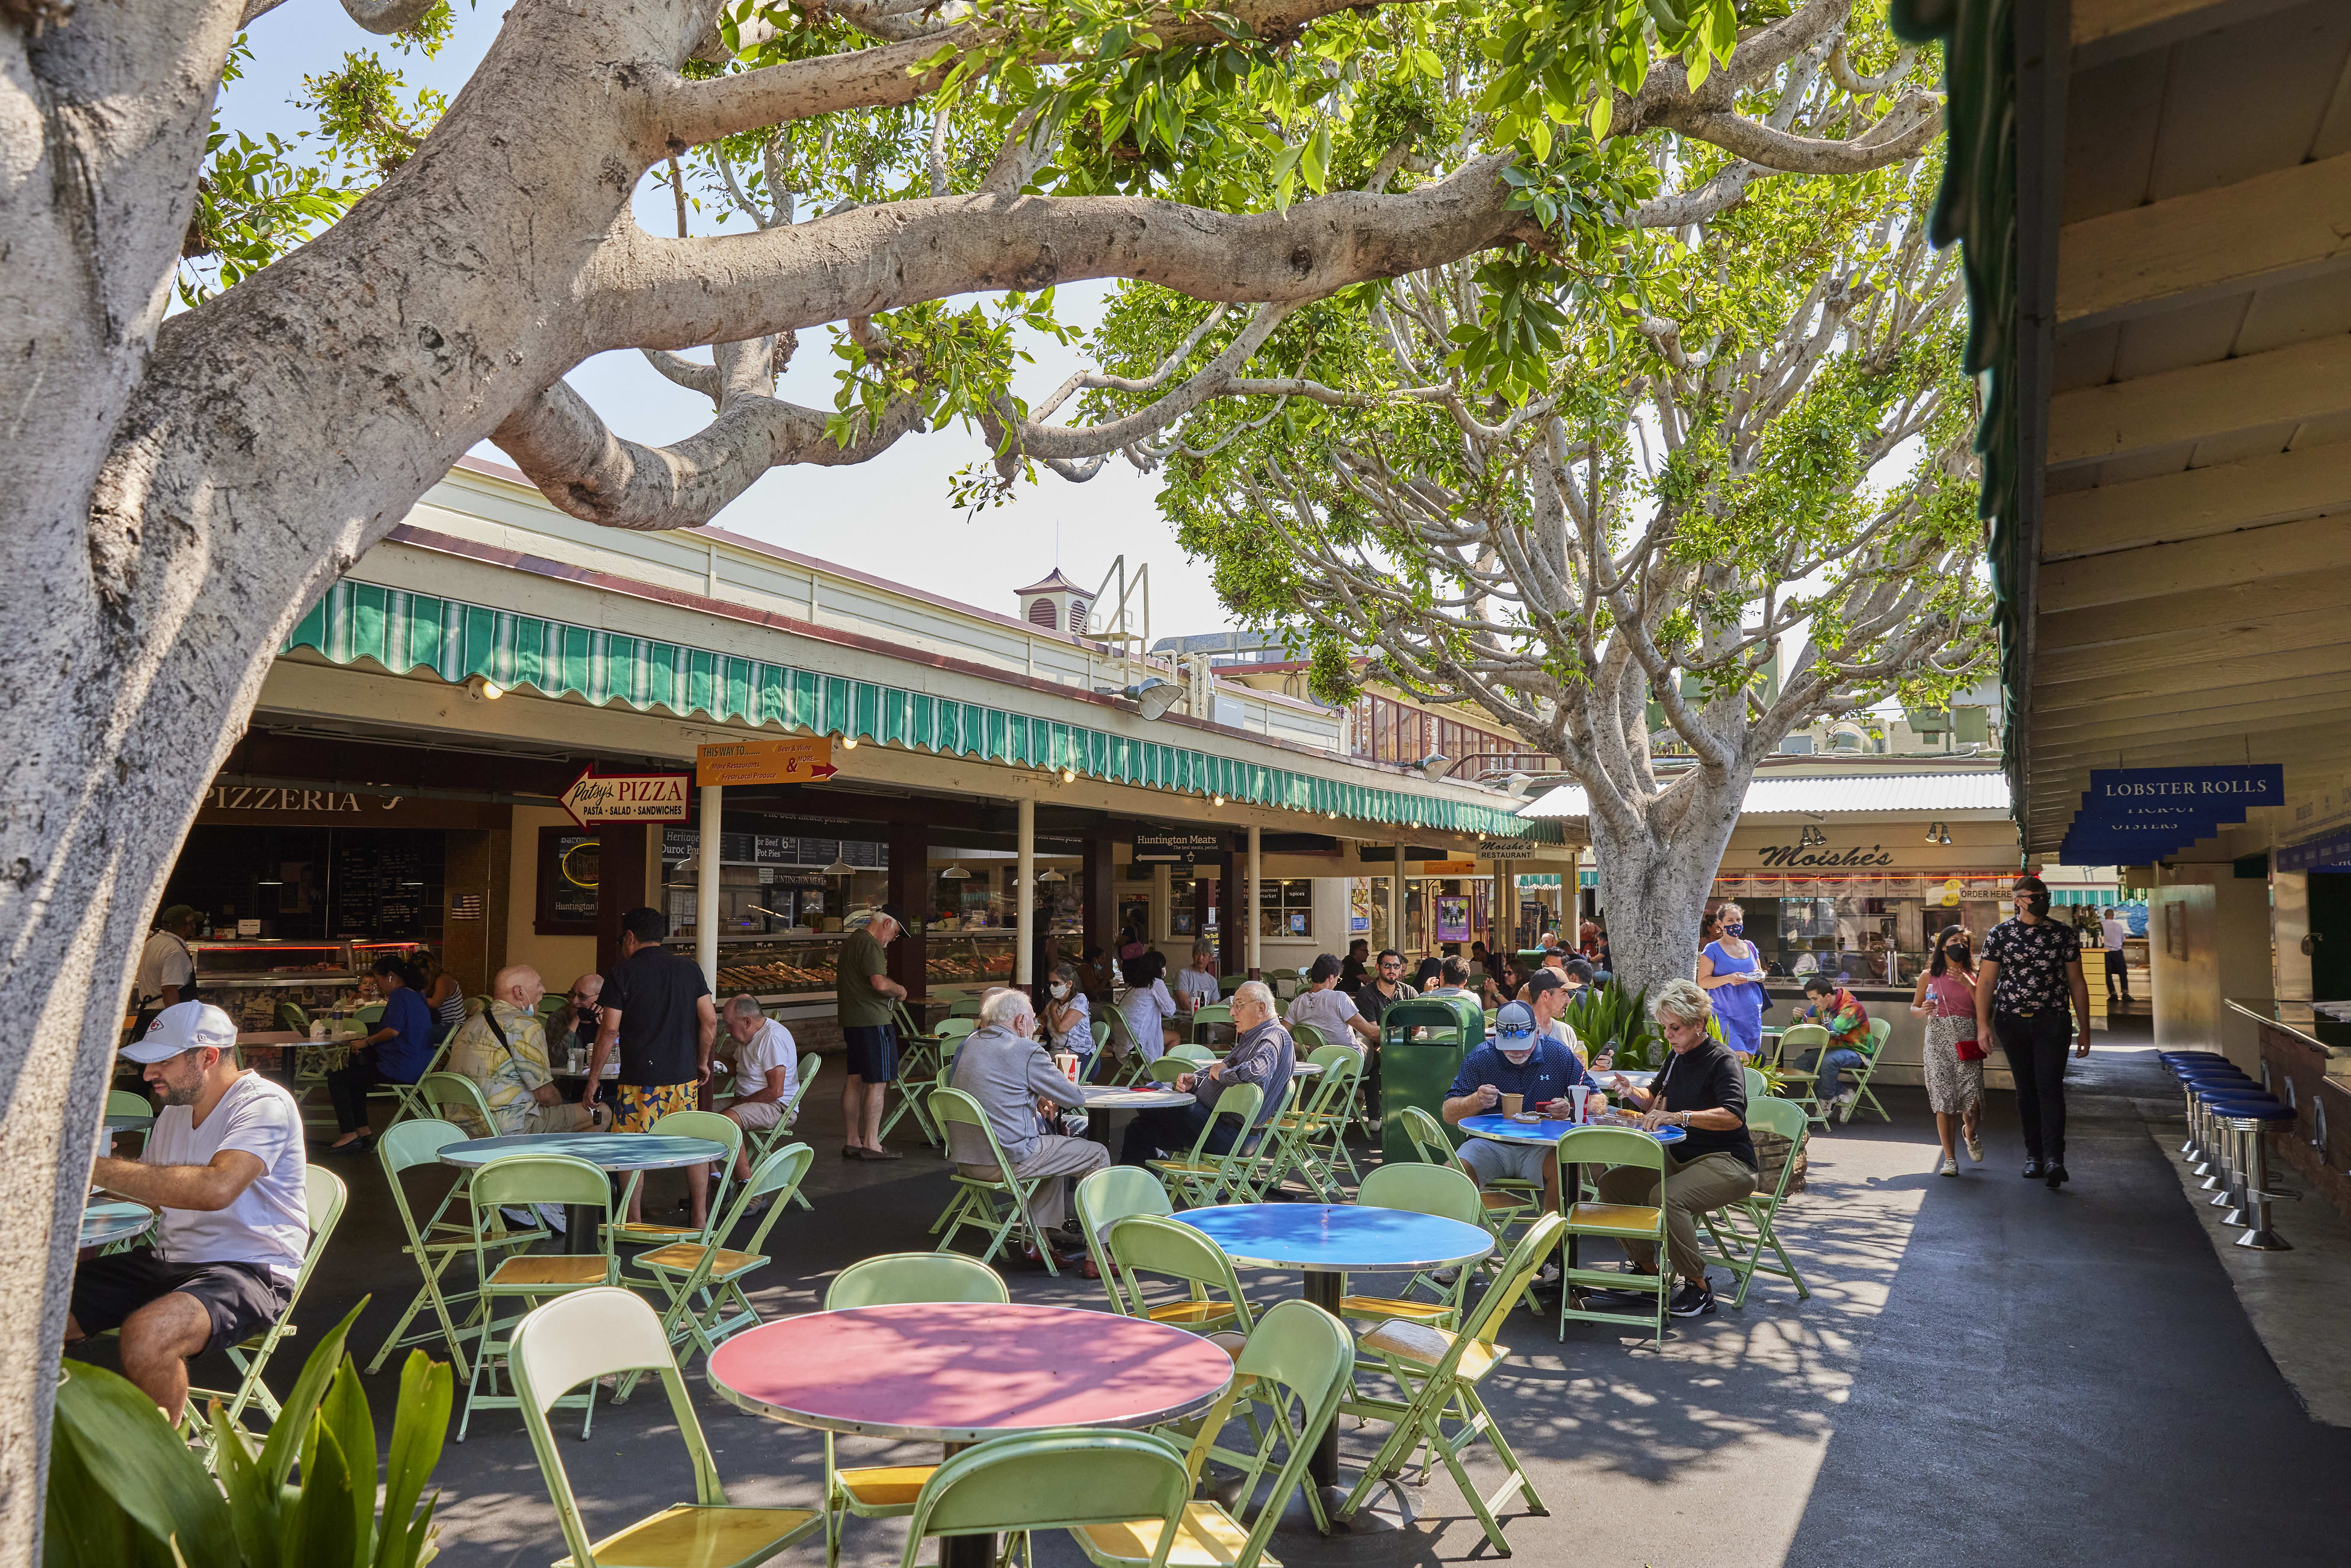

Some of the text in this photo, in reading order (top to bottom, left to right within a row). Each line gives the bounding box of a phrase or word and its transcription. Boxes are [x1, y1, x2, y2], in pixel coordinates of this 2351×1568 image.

[703, 748, 717, 757] THIS
[720, 746, 734, 757] WAY
[786, 757, 798, 773] &
[2105, 779, 2267, 796] LOBSTER ROLLS
[570, 780, 683, 807] Patsy's PIZZA
[583, 805, 682, 815] PASTA SALAD SANDWICHES
[667, 831, 699, 844] Heritage
[765, 838, 779, 846] Beef
[1137, 835, 1216, 846] Huntington Meats
[1479, 841, 1532, 850] Moishe's
[1759, 844, 1894, 867] Moishe's
[773, 875, 809, 885] HUNTINGTON
[555, 902, 595, 912] Huntington
